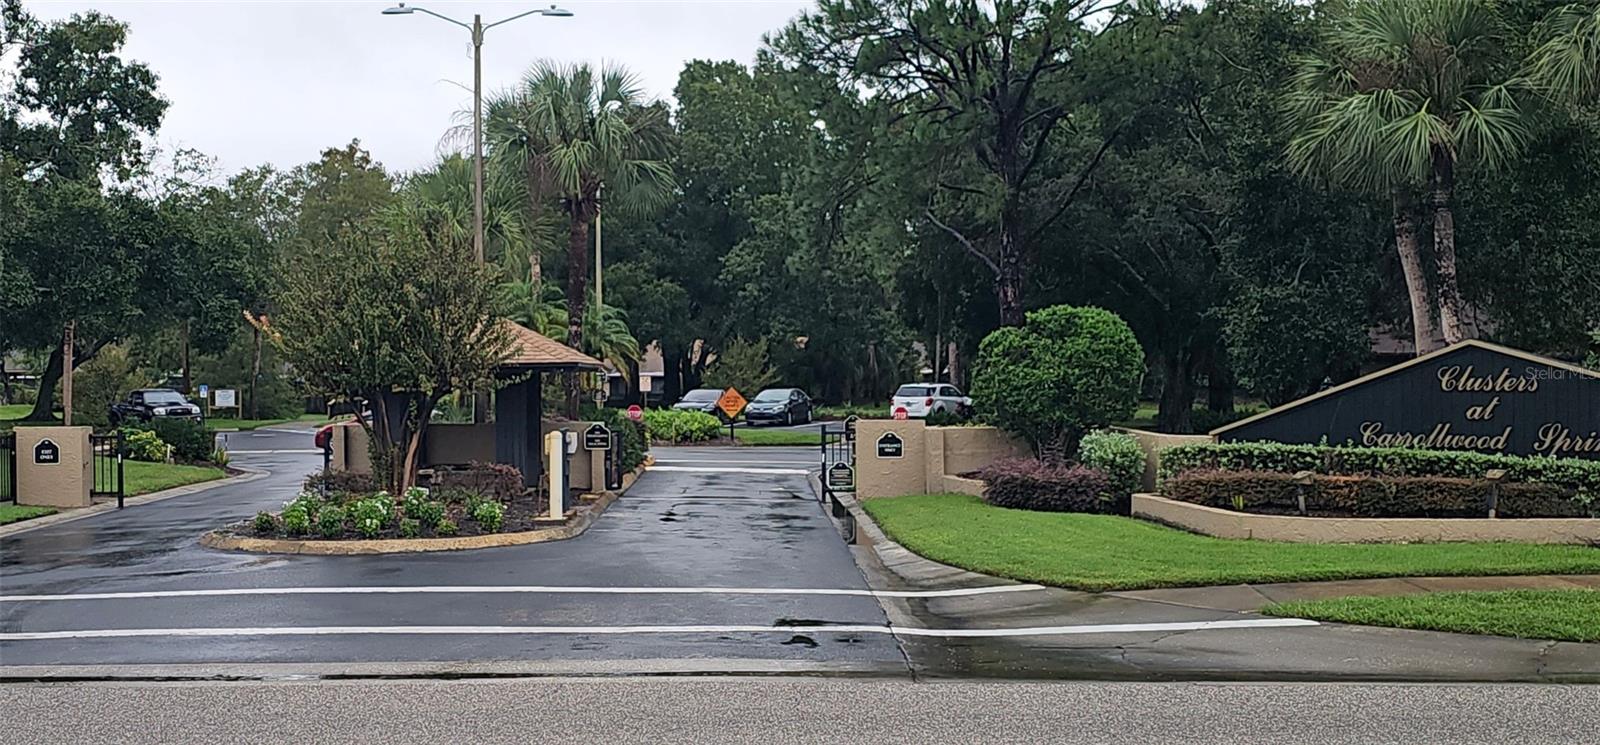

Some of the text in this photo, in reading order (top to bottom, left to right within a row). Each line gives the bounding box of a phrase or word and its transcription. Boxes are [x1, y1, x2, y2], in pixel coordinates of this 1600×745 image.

[1437, 365, 1539, 392] Clusters
[1466, 397, 1500, 420] at
[1360, 421, 1513, 449] Carrollwood
